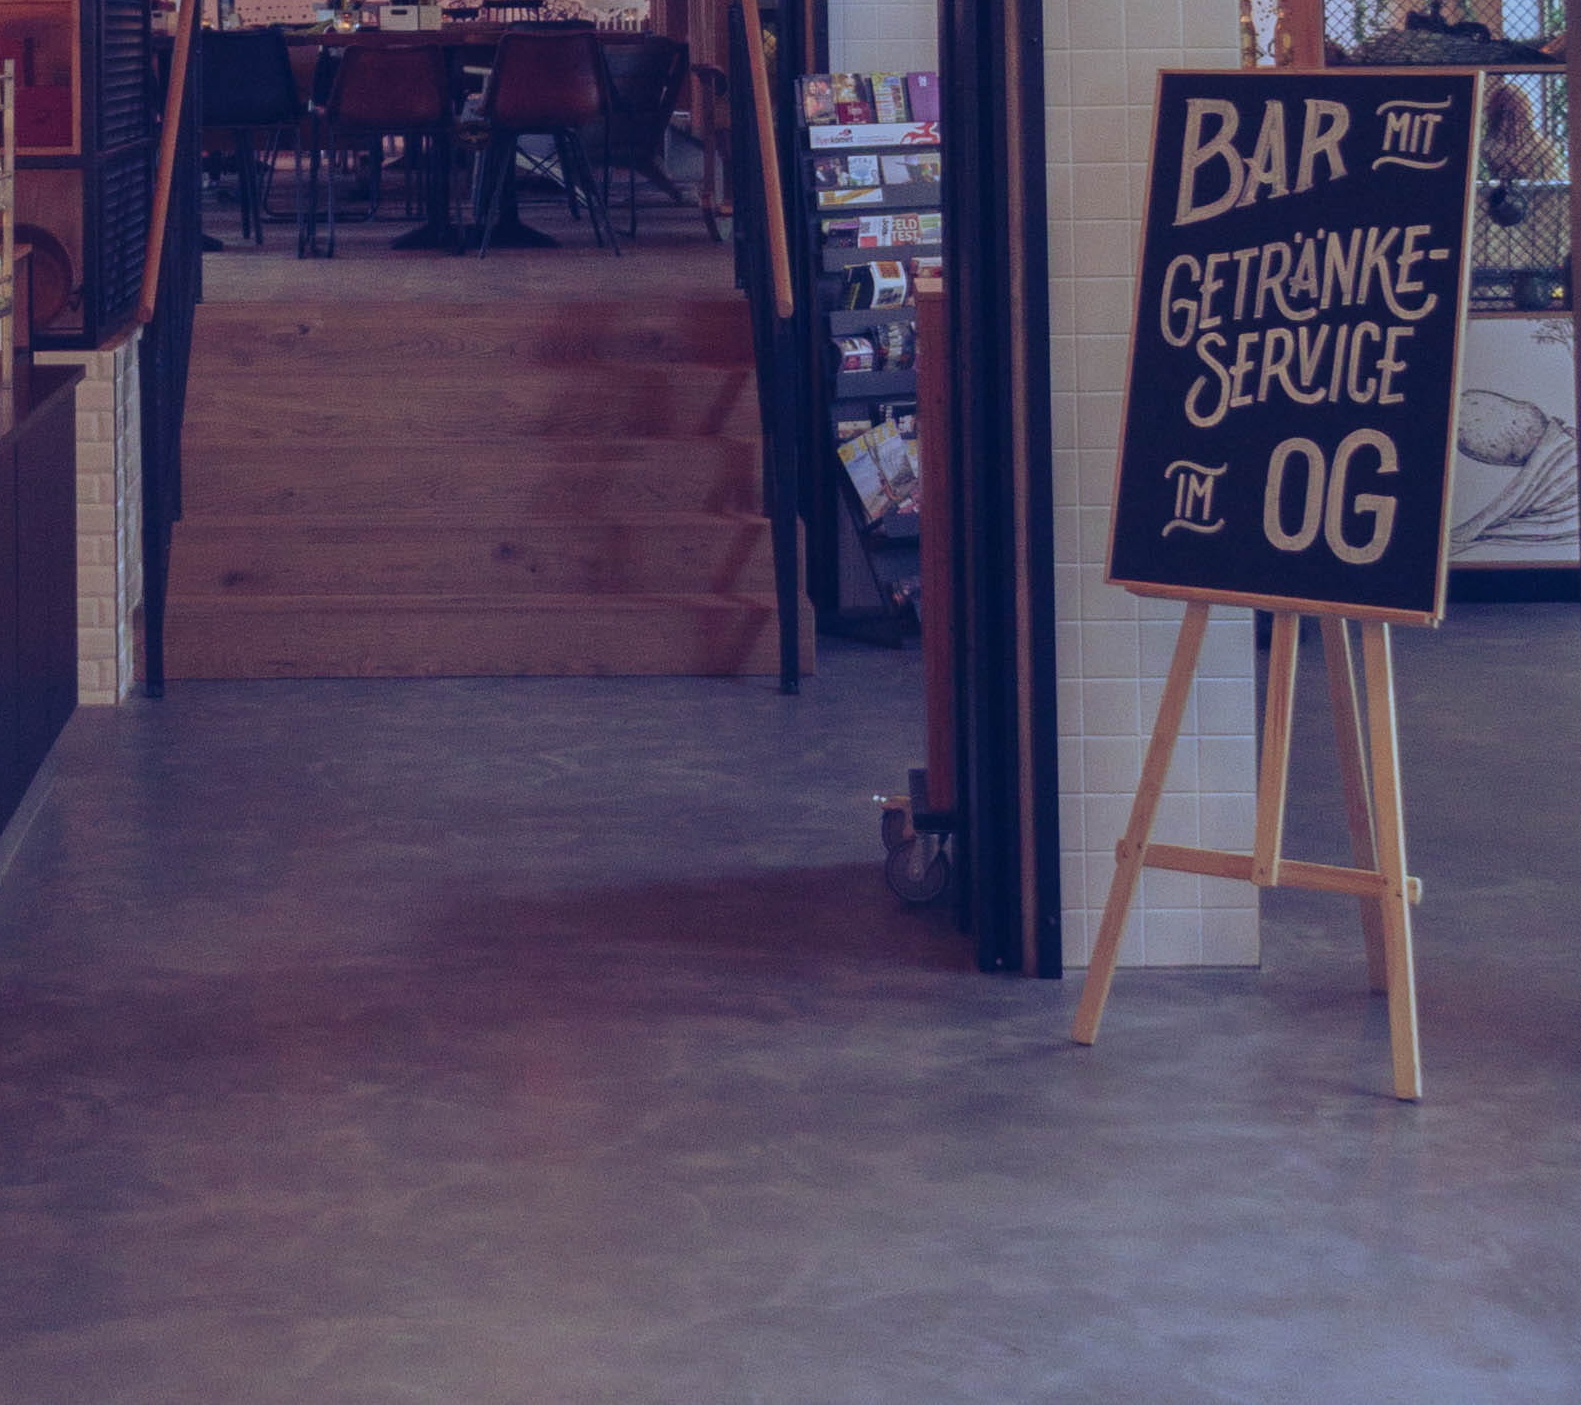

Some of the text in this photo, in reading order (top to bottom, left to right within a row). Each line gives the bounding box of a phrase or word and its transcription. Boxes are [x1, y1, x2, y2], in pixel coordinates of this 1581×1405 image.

[1171, 97, 1443, 227] BAR MIT
[1160, 223, 1451, 348] GETRÄNKE-
[1184, 320, 1416, 429] SERVICE
[1174, 427, 1400, 566] IM OG
